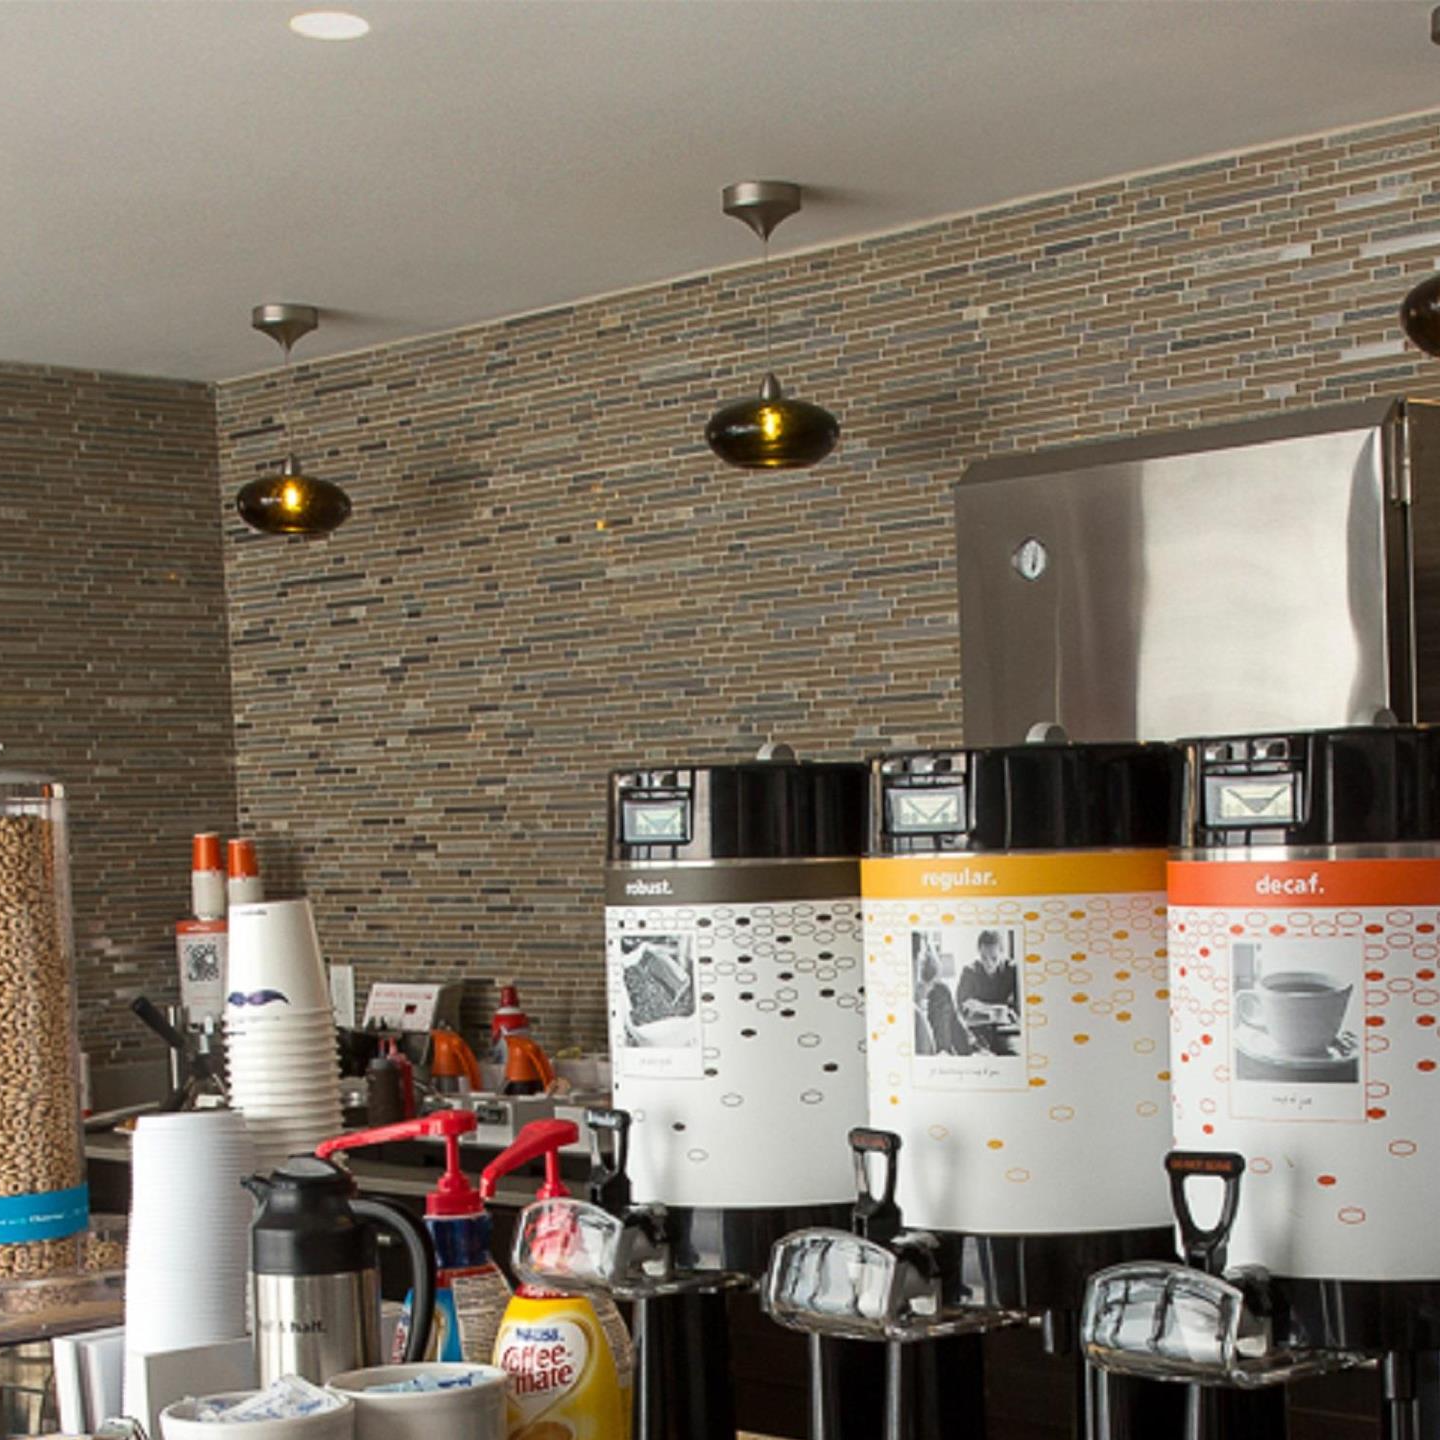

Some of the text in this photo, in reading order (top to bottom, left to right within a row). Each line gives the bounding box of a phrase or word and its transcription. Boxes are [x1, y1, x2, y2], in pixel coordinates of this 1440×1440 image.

[625, 879, 674, 896] robust.
[921, 866, 998, 893] regular.
[1255, 871, 1325, 895] decaf.
